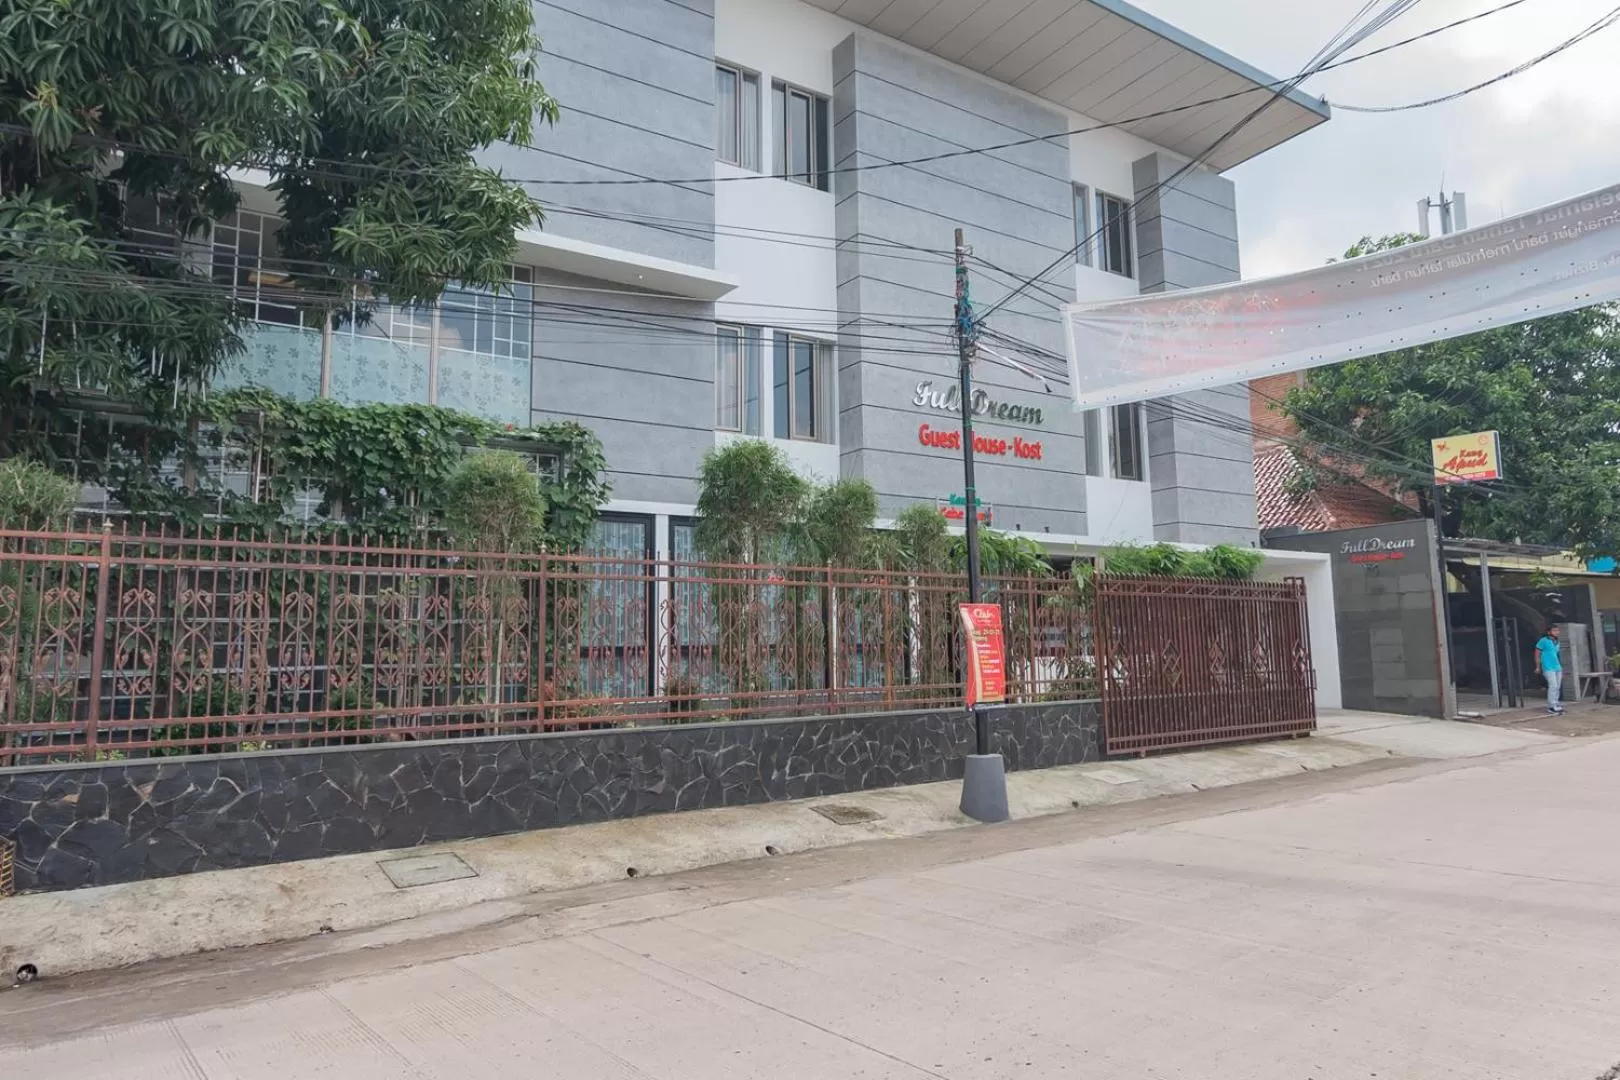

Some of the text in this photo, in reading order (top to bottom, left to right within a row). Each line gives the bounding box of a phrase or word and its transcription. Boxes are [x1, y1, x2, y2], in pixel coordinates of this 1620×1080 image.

[970, 388, 1044, 425] Dream
[918, 423, 961, 450] Guest
[1367, 537, 1416, 553] Dream
